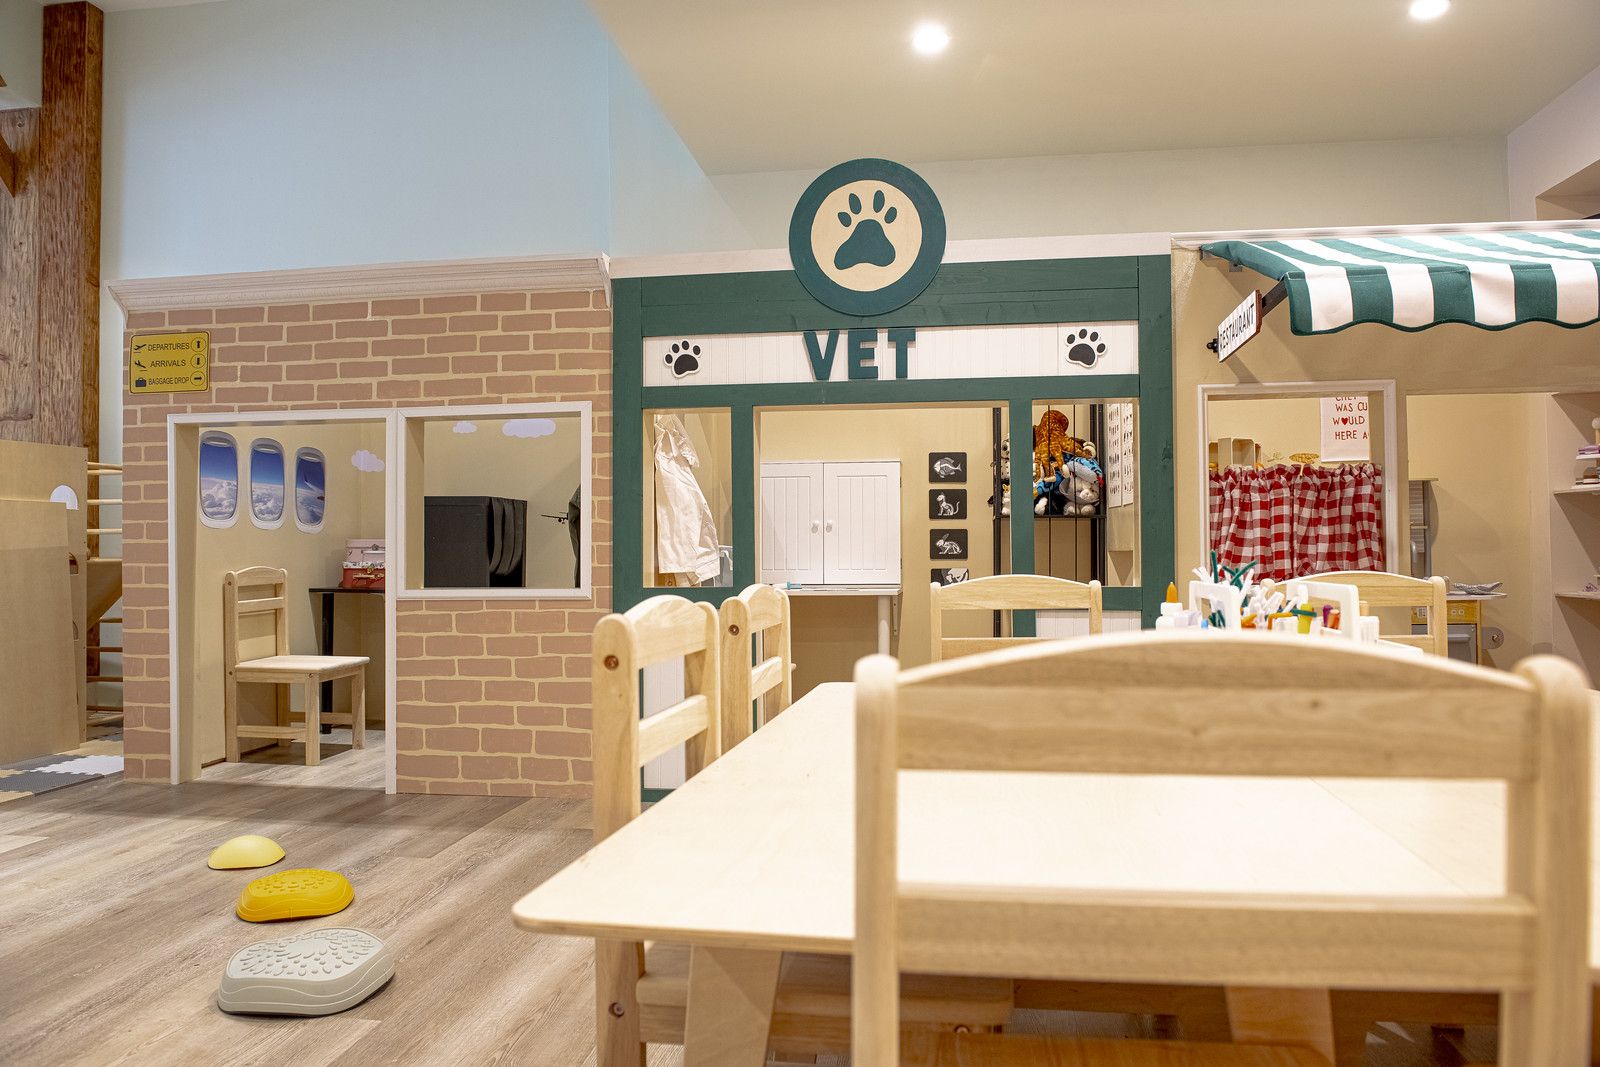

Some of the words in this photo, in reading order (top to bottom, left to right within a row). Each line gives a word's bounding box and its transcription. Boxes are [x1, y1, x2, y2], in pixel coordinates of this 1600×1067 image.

[1219, 303, 1254, 351] RESTAURANT
[147, 342, 190, 351] DEPARTURES
[803, 329, 916, 380] VET
[150, 359, 187, 368] ARRIVALS
[148, 377, 174, 386] BAGGAGE
[174, 376, 190, 385] DROP
[1335, 403, 1354, 412] WAS
[1335, 430, 1358, 440] HERE
